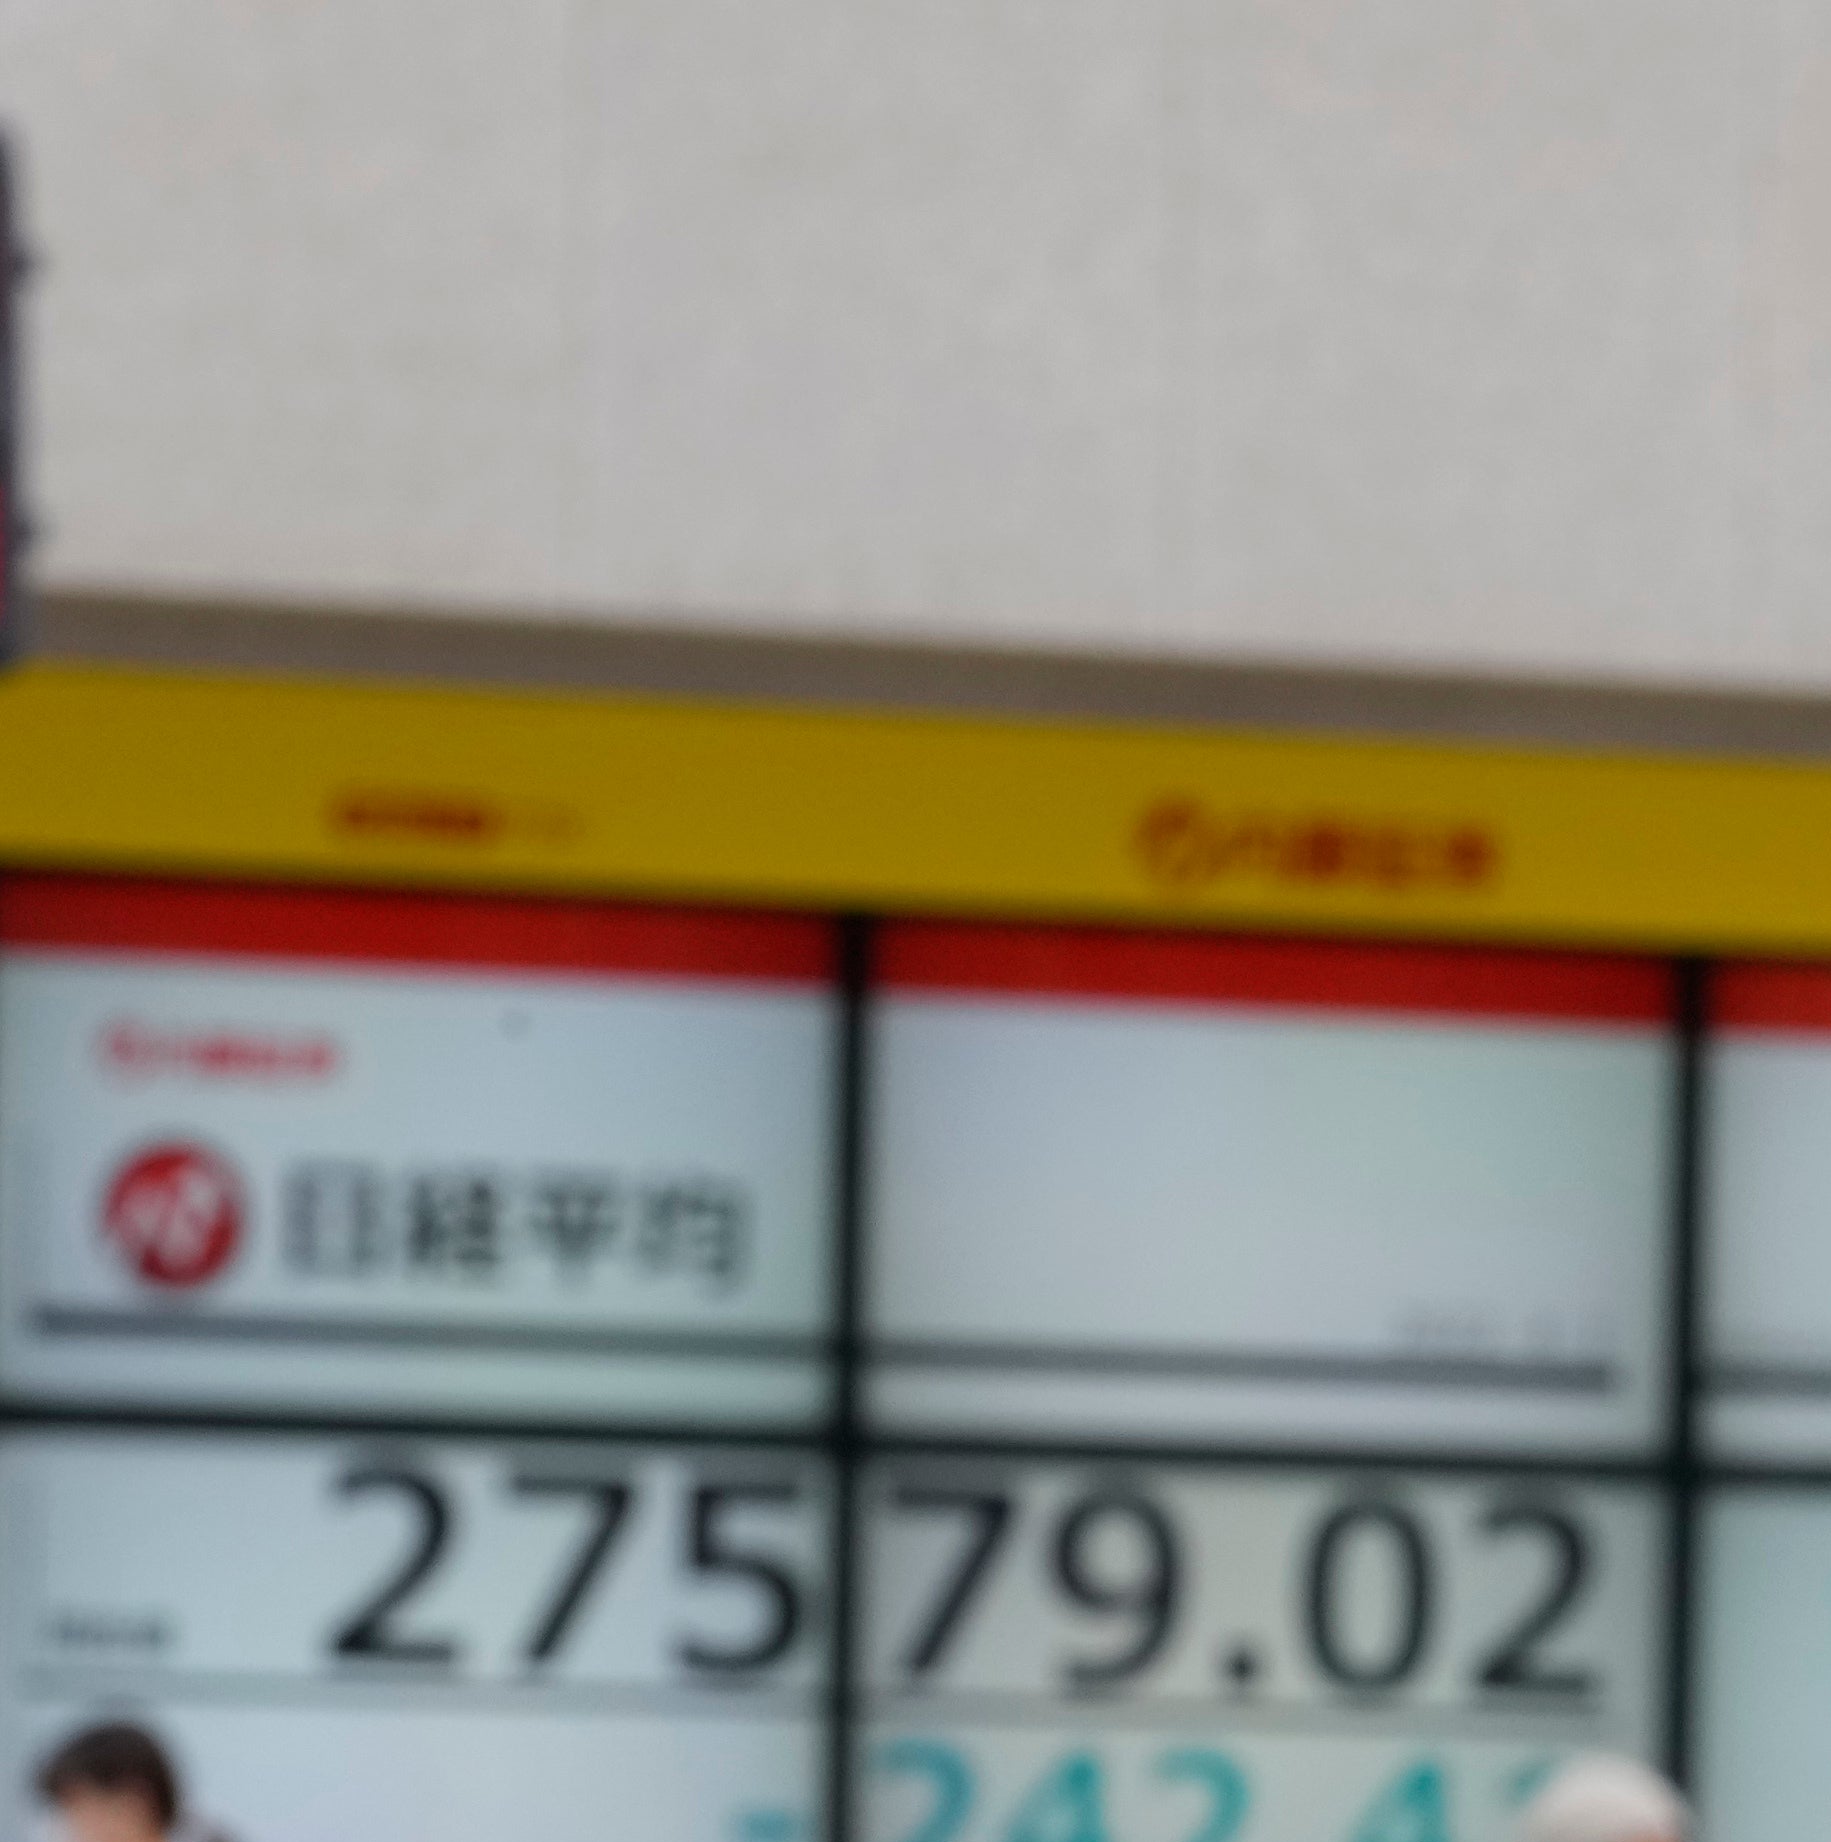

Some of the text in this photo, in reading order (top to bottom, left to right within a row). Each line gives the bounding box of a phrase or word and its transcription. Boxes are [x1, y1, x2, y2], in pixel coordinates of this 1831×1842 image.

[280, 1156, 752, 1298] 日経平均
[328, 1460, 1602, 1698] 27579.02
